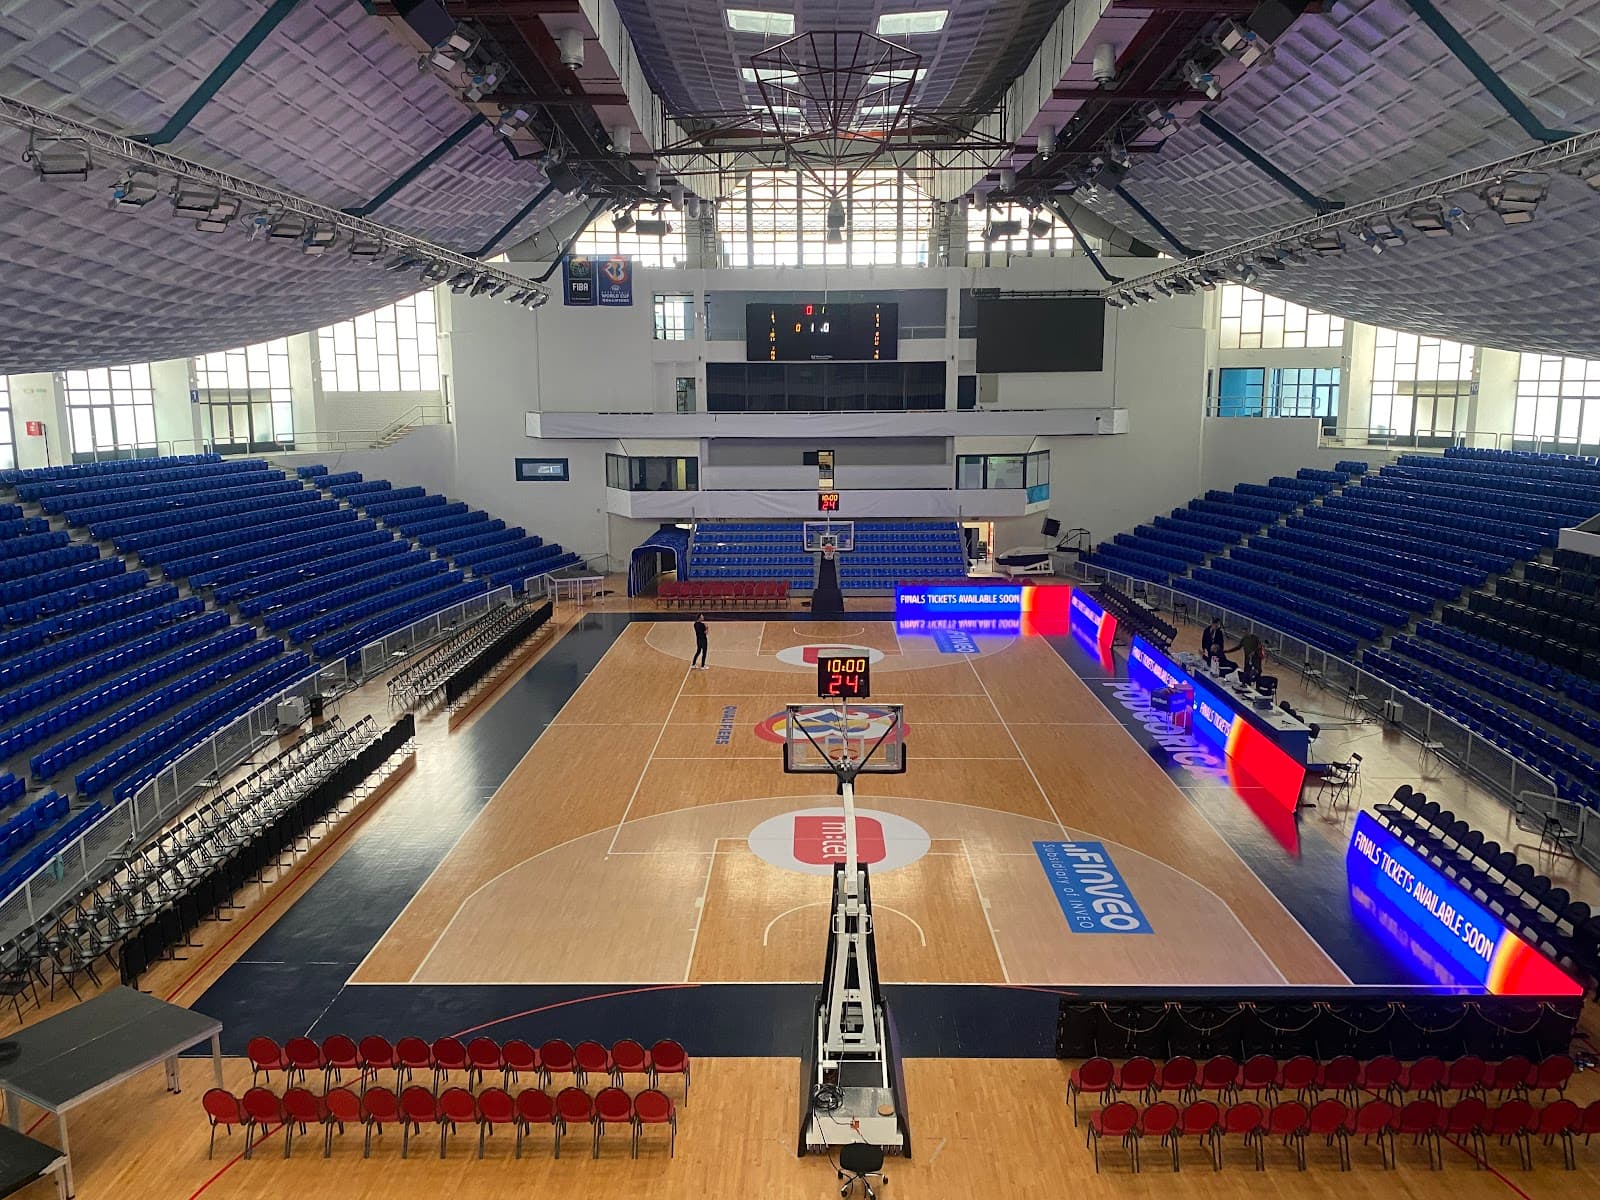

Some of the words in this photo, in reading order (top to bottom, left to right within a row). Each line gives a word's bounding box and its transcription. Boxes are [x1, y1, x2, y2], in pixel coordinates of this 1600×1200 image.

[572, 282, 589, 292] FIBA
[823, 501, 836, 510] 24
[900, 594, 926, 604] FINALS
[927, 594, 957, 604] TICKETS
[958, 594, 998, 604] AVAILABLE
[998, 594, 1020, 604] SOON
[827, 659, 866, 673] 10:00
[830, 674, 858, 694] 24
[715, 705, 737, 745] QUALIFIERS
[1042, 844, 1070, 884] Subsidiary
[1063, 887, 1080, 897] of
[1354, 831, 1382, 865] FINALS
[1380, 852, 1415, 893] TICKETS
[1413, 881, 1464, 936] AVAILABLE
[1461, 922, 1495, 962] SOON
[1069, 899, 1094, 929] INVEO
